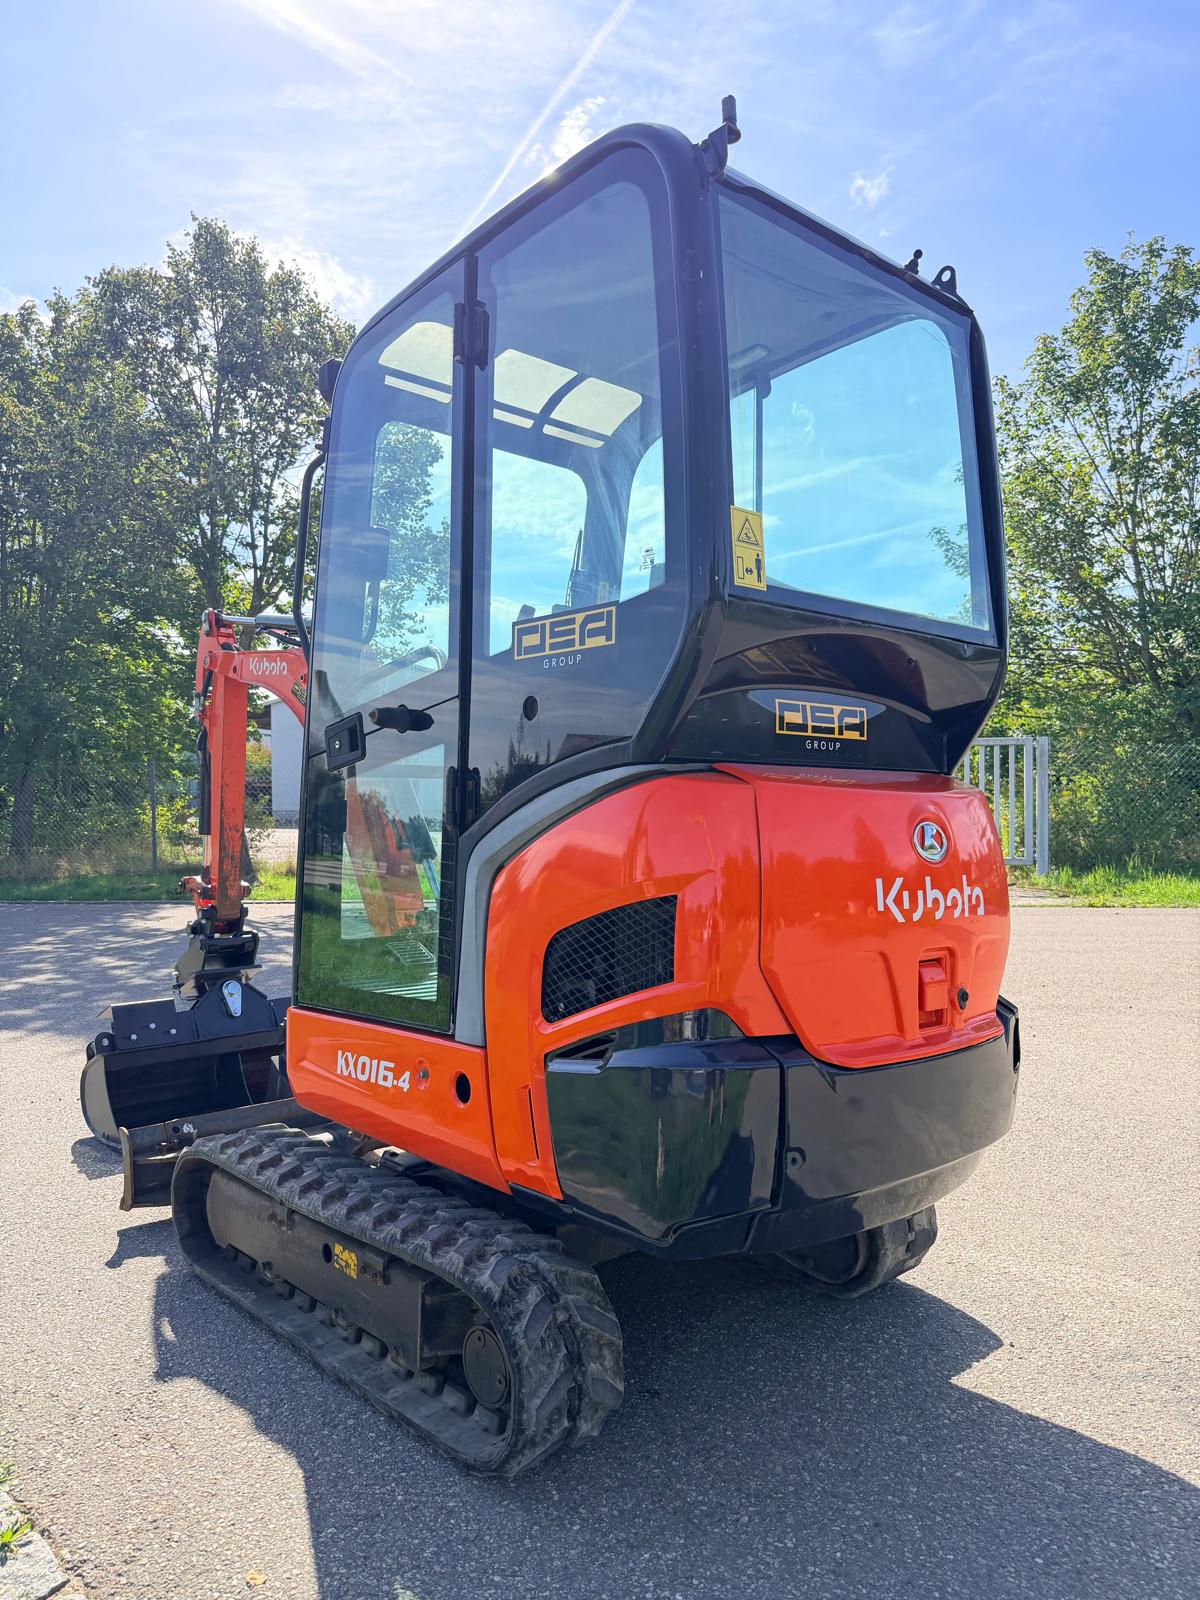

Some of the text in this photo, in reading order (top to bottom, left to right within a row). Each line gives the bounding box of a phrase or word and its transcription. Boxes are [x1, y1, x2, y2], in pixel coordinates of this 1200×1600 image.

[249, 657, 288, 675] Kubota
[543, 654, 582, 669] GROUP
[805, 739, 841, 751] GROUP
[875, 874, 984, 923] Kubota
